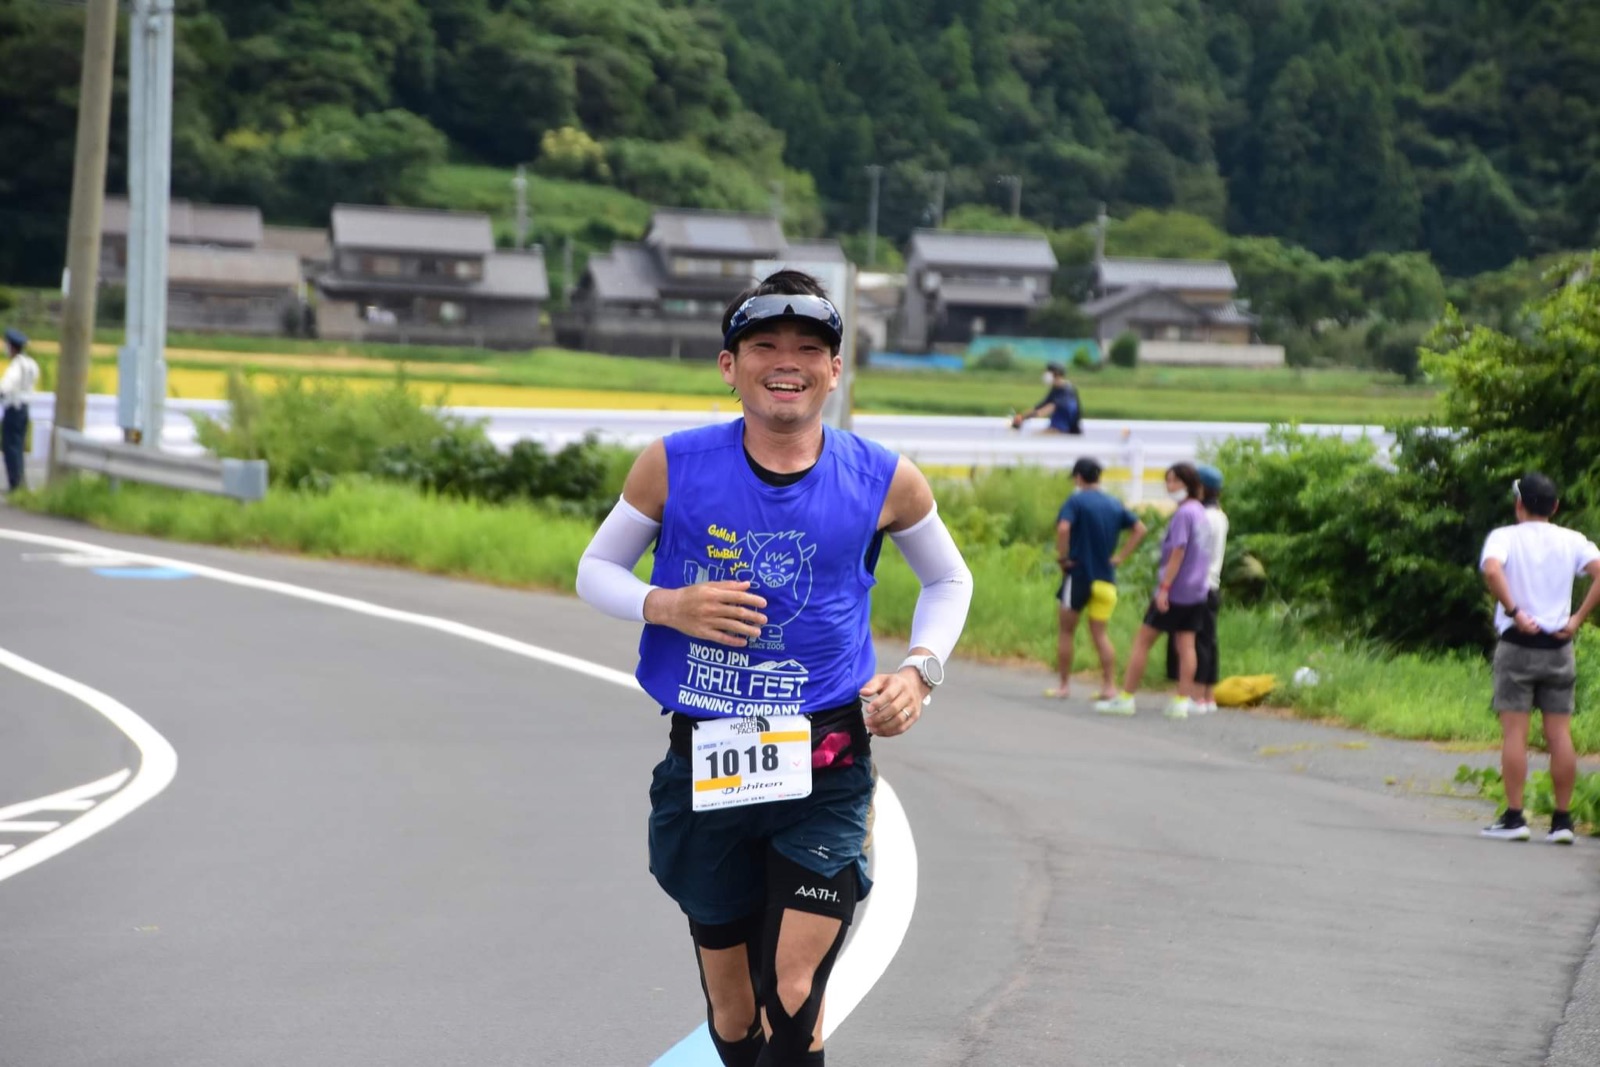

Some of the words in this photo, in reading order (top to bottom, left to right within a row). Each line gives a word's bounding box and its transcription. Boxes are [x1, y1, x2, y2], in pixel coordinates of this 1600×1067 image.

[689, 642, 725, 663] KYOTO
[726, 651, 750, 668] JPN
[687, 660, 742, 696] TRAIL
[748, 674, 809, 698] FEST
[678, 689, 734, 714] RUNNING
[735, 703, 800, 717] COMPANY
[730, 721, 757, 730] NORTH
[705, 744, 779, 779] 1018
[736, 781, 783, 794] phiten
